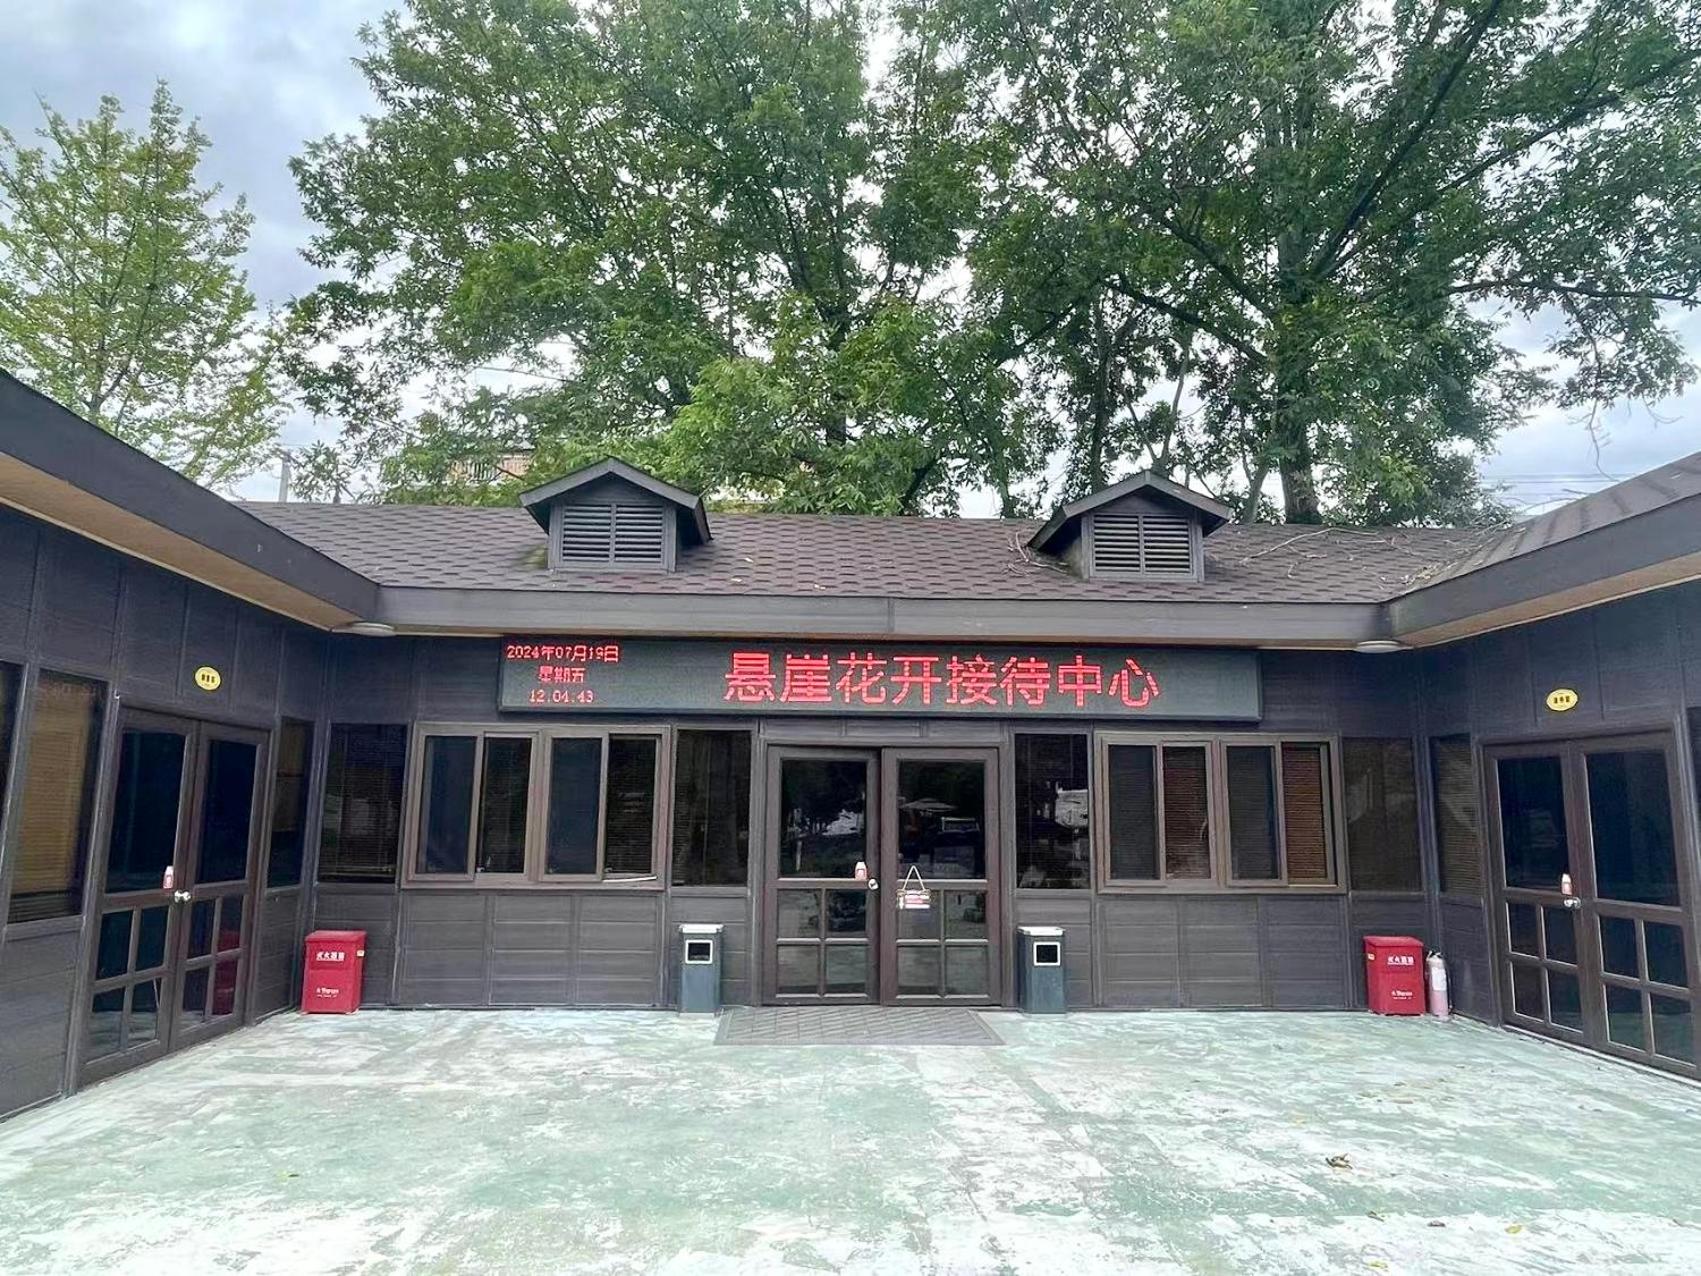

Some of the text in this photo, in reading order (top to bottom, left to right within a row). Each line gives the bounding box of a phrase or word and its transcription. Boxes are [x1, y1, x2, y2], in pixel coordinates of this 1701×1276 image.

[506, 644, 619, 663] 2024年07月19日
[538, 664, 586, 684] 星期五
[722, 651, 1160, 708] 悬崖花开接待中心
